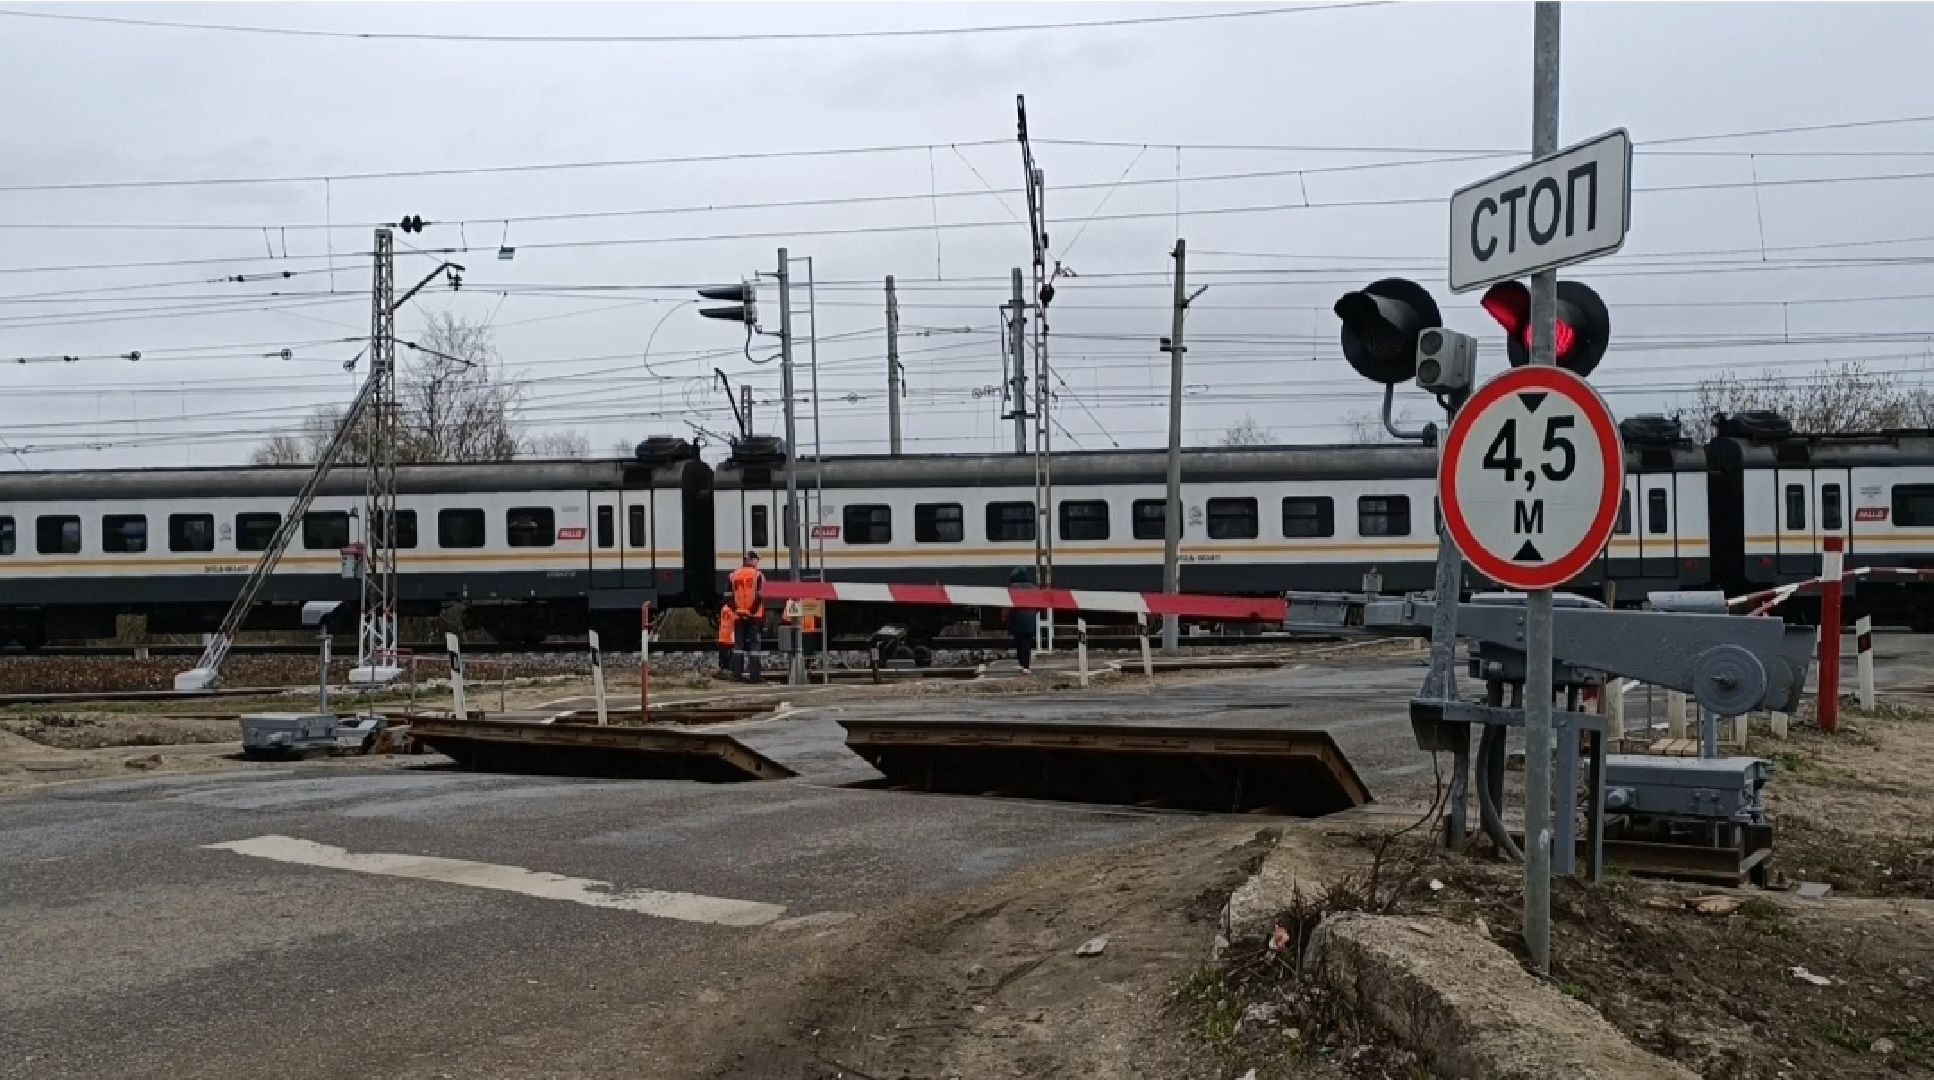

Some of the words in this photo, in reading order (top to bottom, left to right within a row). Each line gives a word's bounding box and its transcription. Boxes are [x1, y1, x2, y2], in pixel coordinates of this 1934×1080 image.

[1471, 161, 1597, 261] СТОП
[1483, 415, 1576, 492] 4,5
[1514, 499, 1543, 533] М
